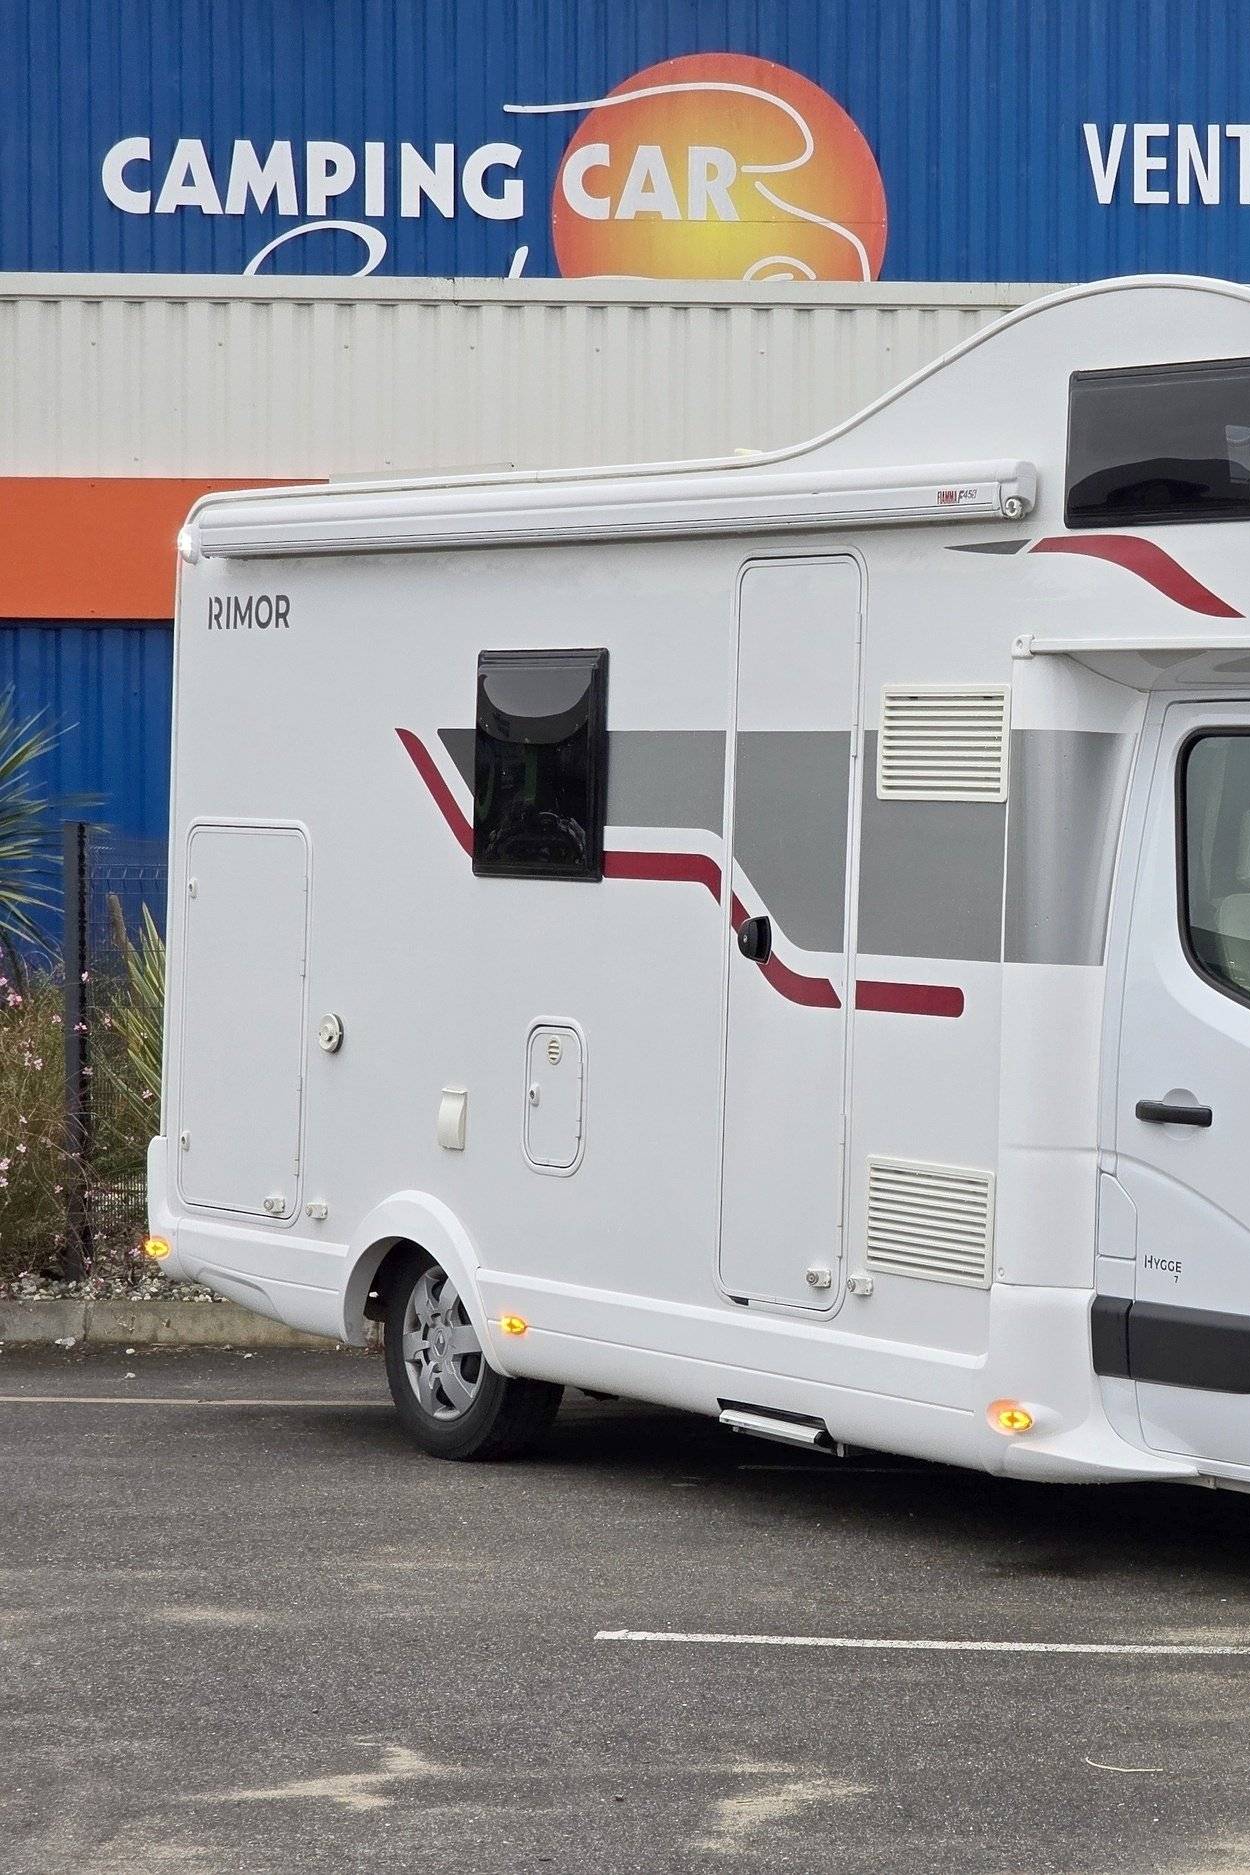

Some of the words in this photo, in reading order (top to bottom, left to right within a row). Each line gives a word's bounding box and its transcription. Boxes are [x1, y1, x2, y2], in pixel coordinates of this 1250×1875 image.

[102, 137, 524, 220] CAMPING
[562, 143, 740, 222] CAR
[208, 595, 290, 629] RIMOR
[1144, 1254, 1182, 1273] HYGGE
